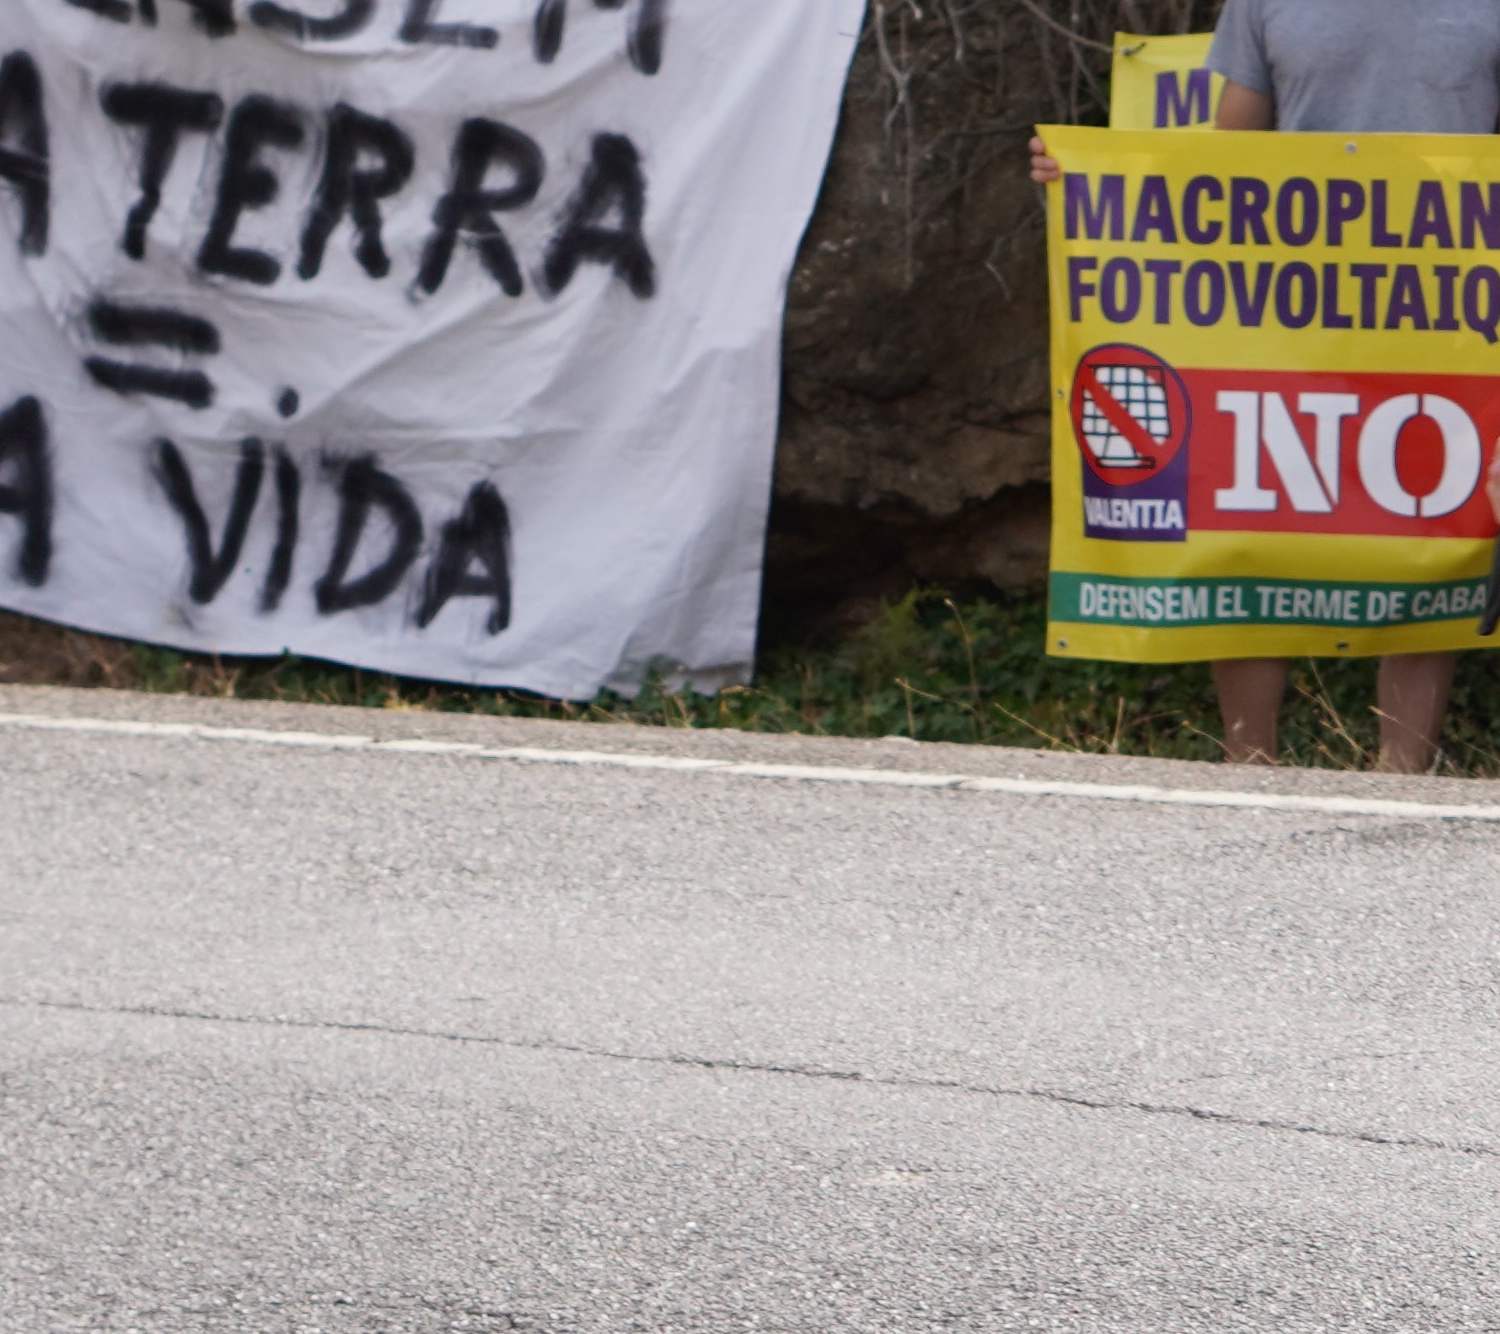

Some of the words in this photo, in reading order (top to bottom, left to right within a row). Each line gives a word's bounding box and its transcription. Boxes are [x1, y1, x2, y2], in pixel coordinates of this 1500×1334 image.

[102, 81, 657, 301] TERRA
[1214, 389, 1483, 519] NO
[1083, 496, 1186, 531] VALENTIA
[1080, 581, 1209, 622] DEFENSEM
[1215, 585, 1248, 619] EL
[1255, 585, 1360, 622] TERME
[1366, 589, 1404, 622] DE
